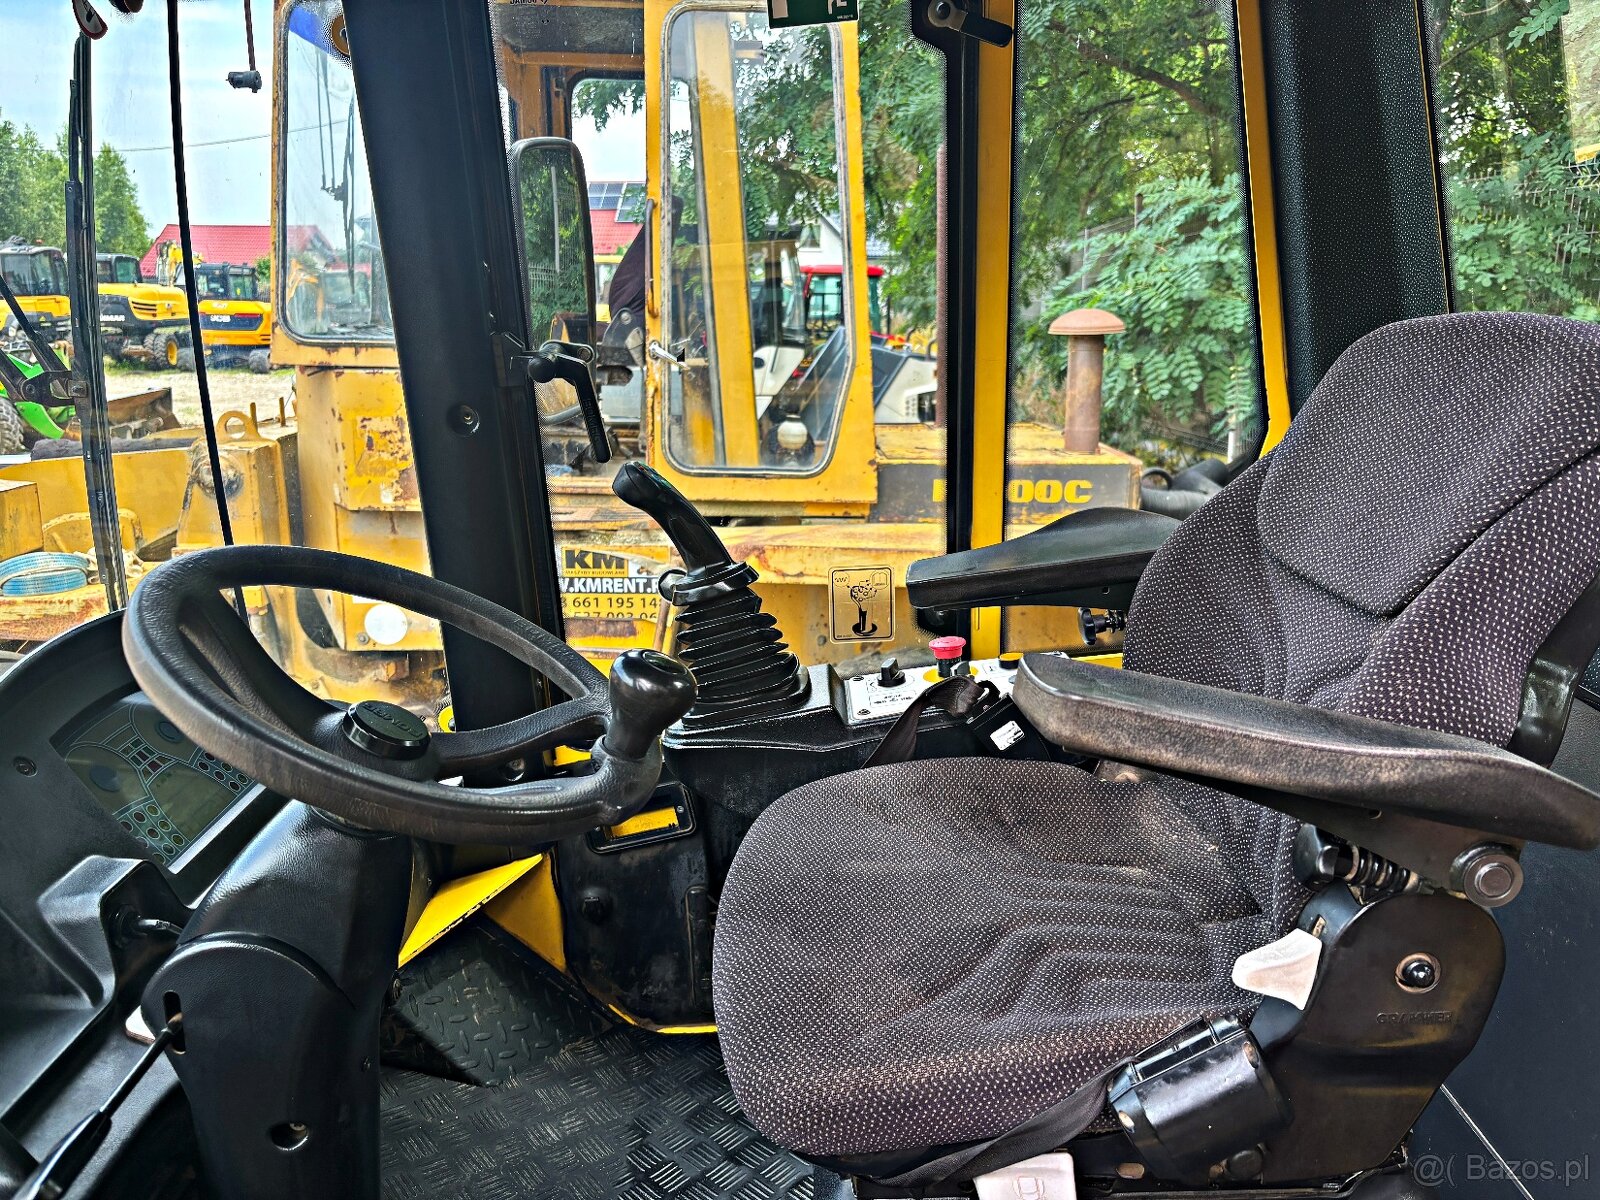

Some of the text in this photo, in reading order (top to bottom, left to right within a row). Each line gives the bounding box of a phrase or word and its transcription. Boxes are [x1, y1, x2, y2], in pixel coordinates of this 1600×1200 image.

[565, 550, 624, 569] KM
[573, 597, 599, 608] 661
[607, 597, 634, 608] 195
